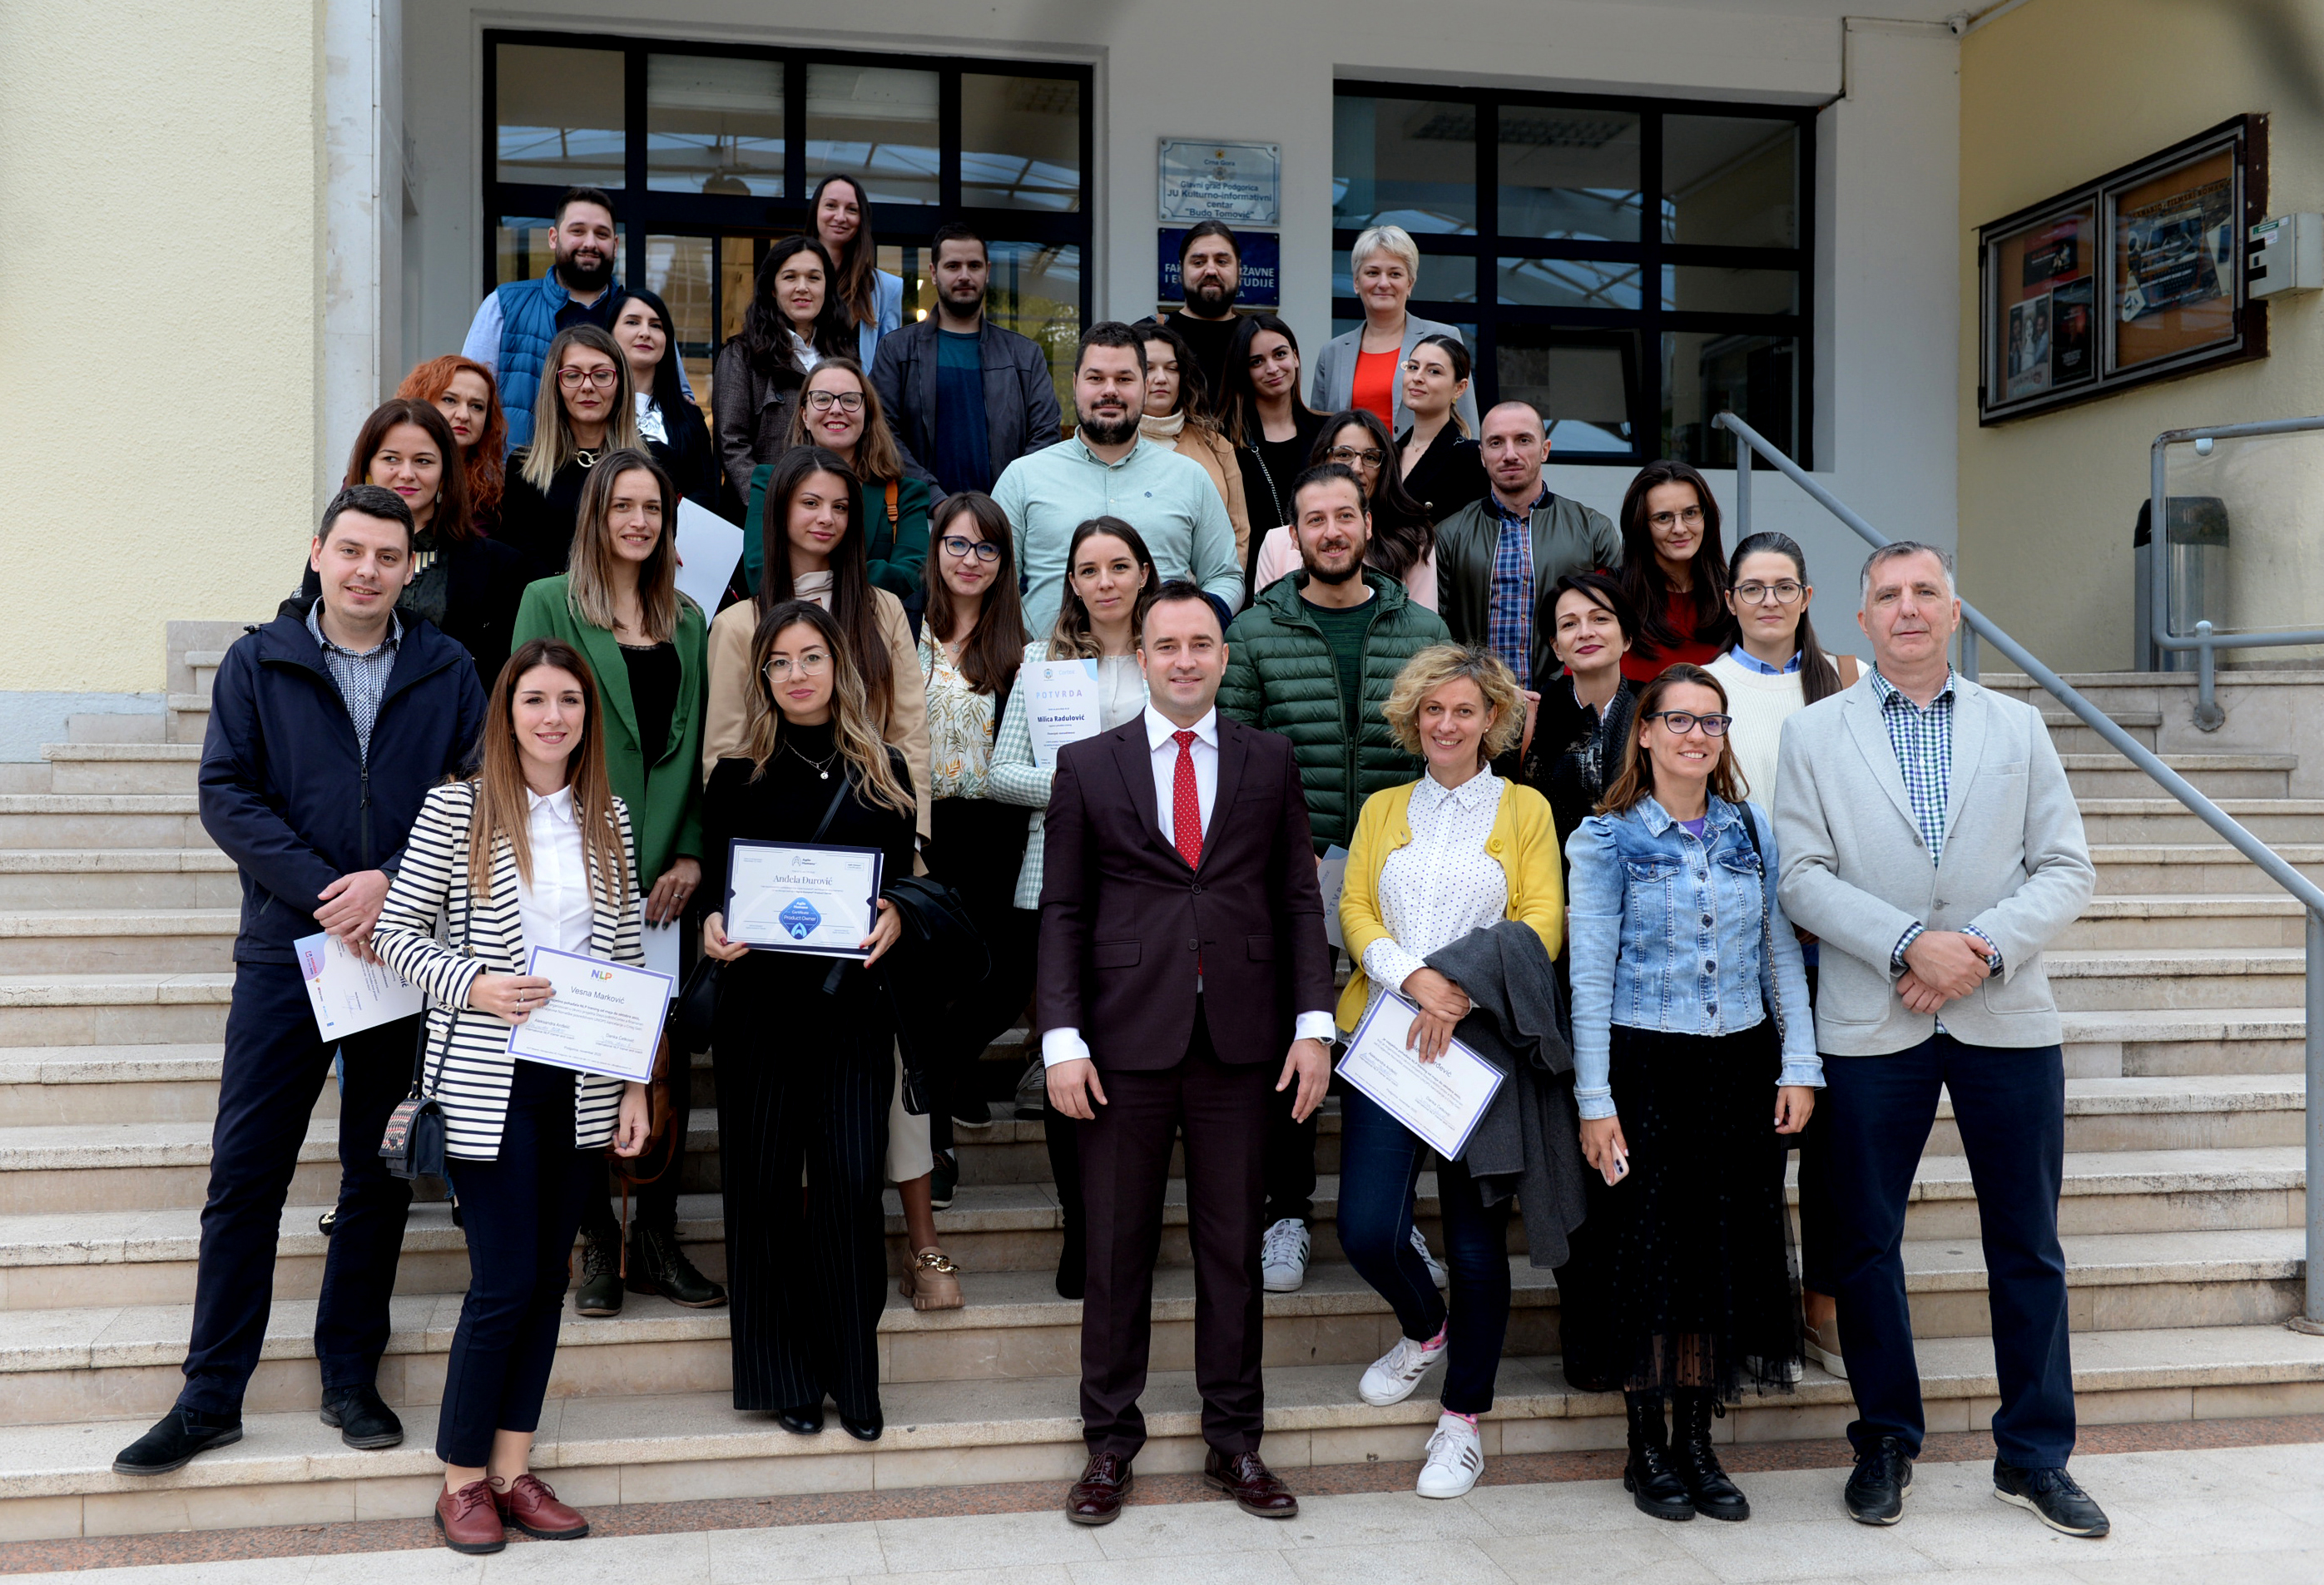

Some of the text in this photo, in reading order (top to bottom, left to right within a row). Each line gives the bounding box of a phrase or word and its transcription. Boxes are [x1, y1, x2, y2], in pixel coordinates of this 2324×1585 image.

[1181, 181, 1259, 192] Glavni grad Podgorica
[1182, 190, 1272, 202] Kulturno-informativni
[1207, 201, 1233, 209] centar
[1036, 689, 1083, 699] POTVRDA
[1054, 714, 1085, 722] Radulović
[802, 876, 833, 886] Đurović
[591, 968, 613, 981] NLP
[571, 985, 625, 1004] Vesna Marković
